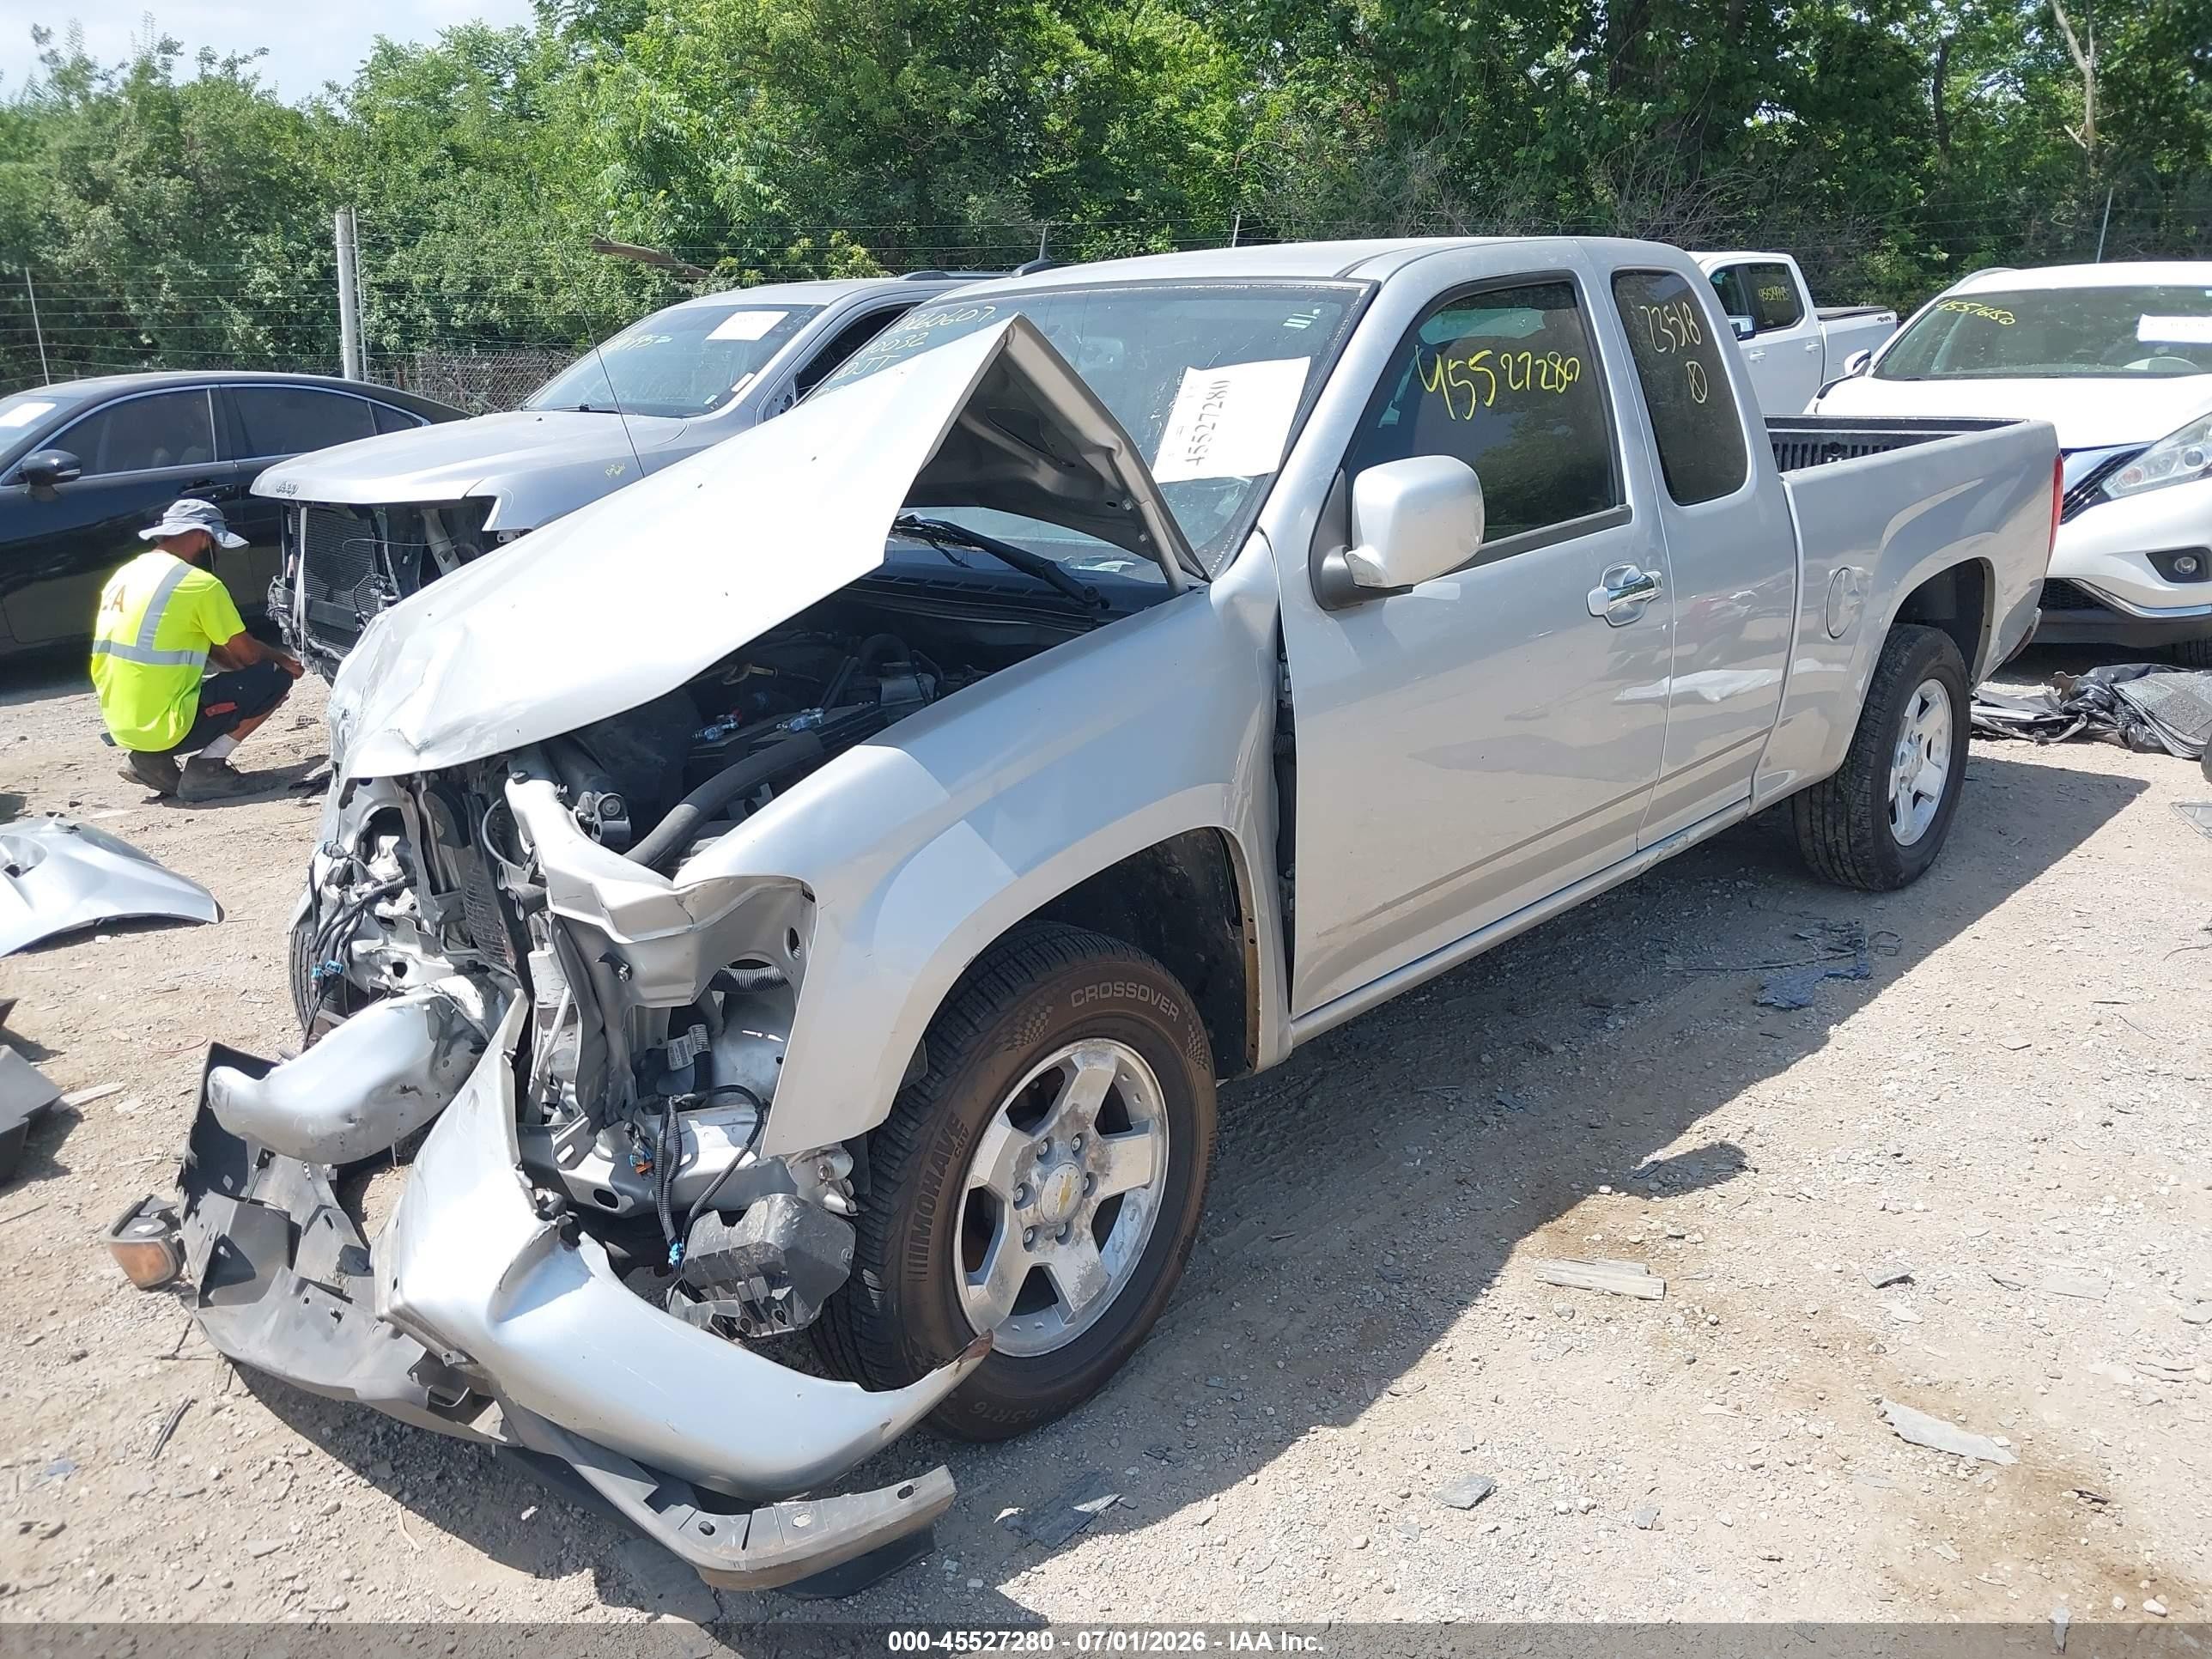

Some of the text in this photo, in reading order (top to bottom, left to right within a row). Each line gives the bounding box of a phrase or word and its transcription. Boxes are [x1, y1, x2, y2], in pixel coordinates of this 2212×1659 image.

[1639, 301, 1701, 354] 23518
[1415, 344, 1580, 421] 45527280
[1184, 380, 1231, 466] 45527280
[1071, 981, 1180, 1022] CROSSOVER
[954, 1126, 969, 1159] CUV
[909, 1113, 964, 1244] MOHAVE
